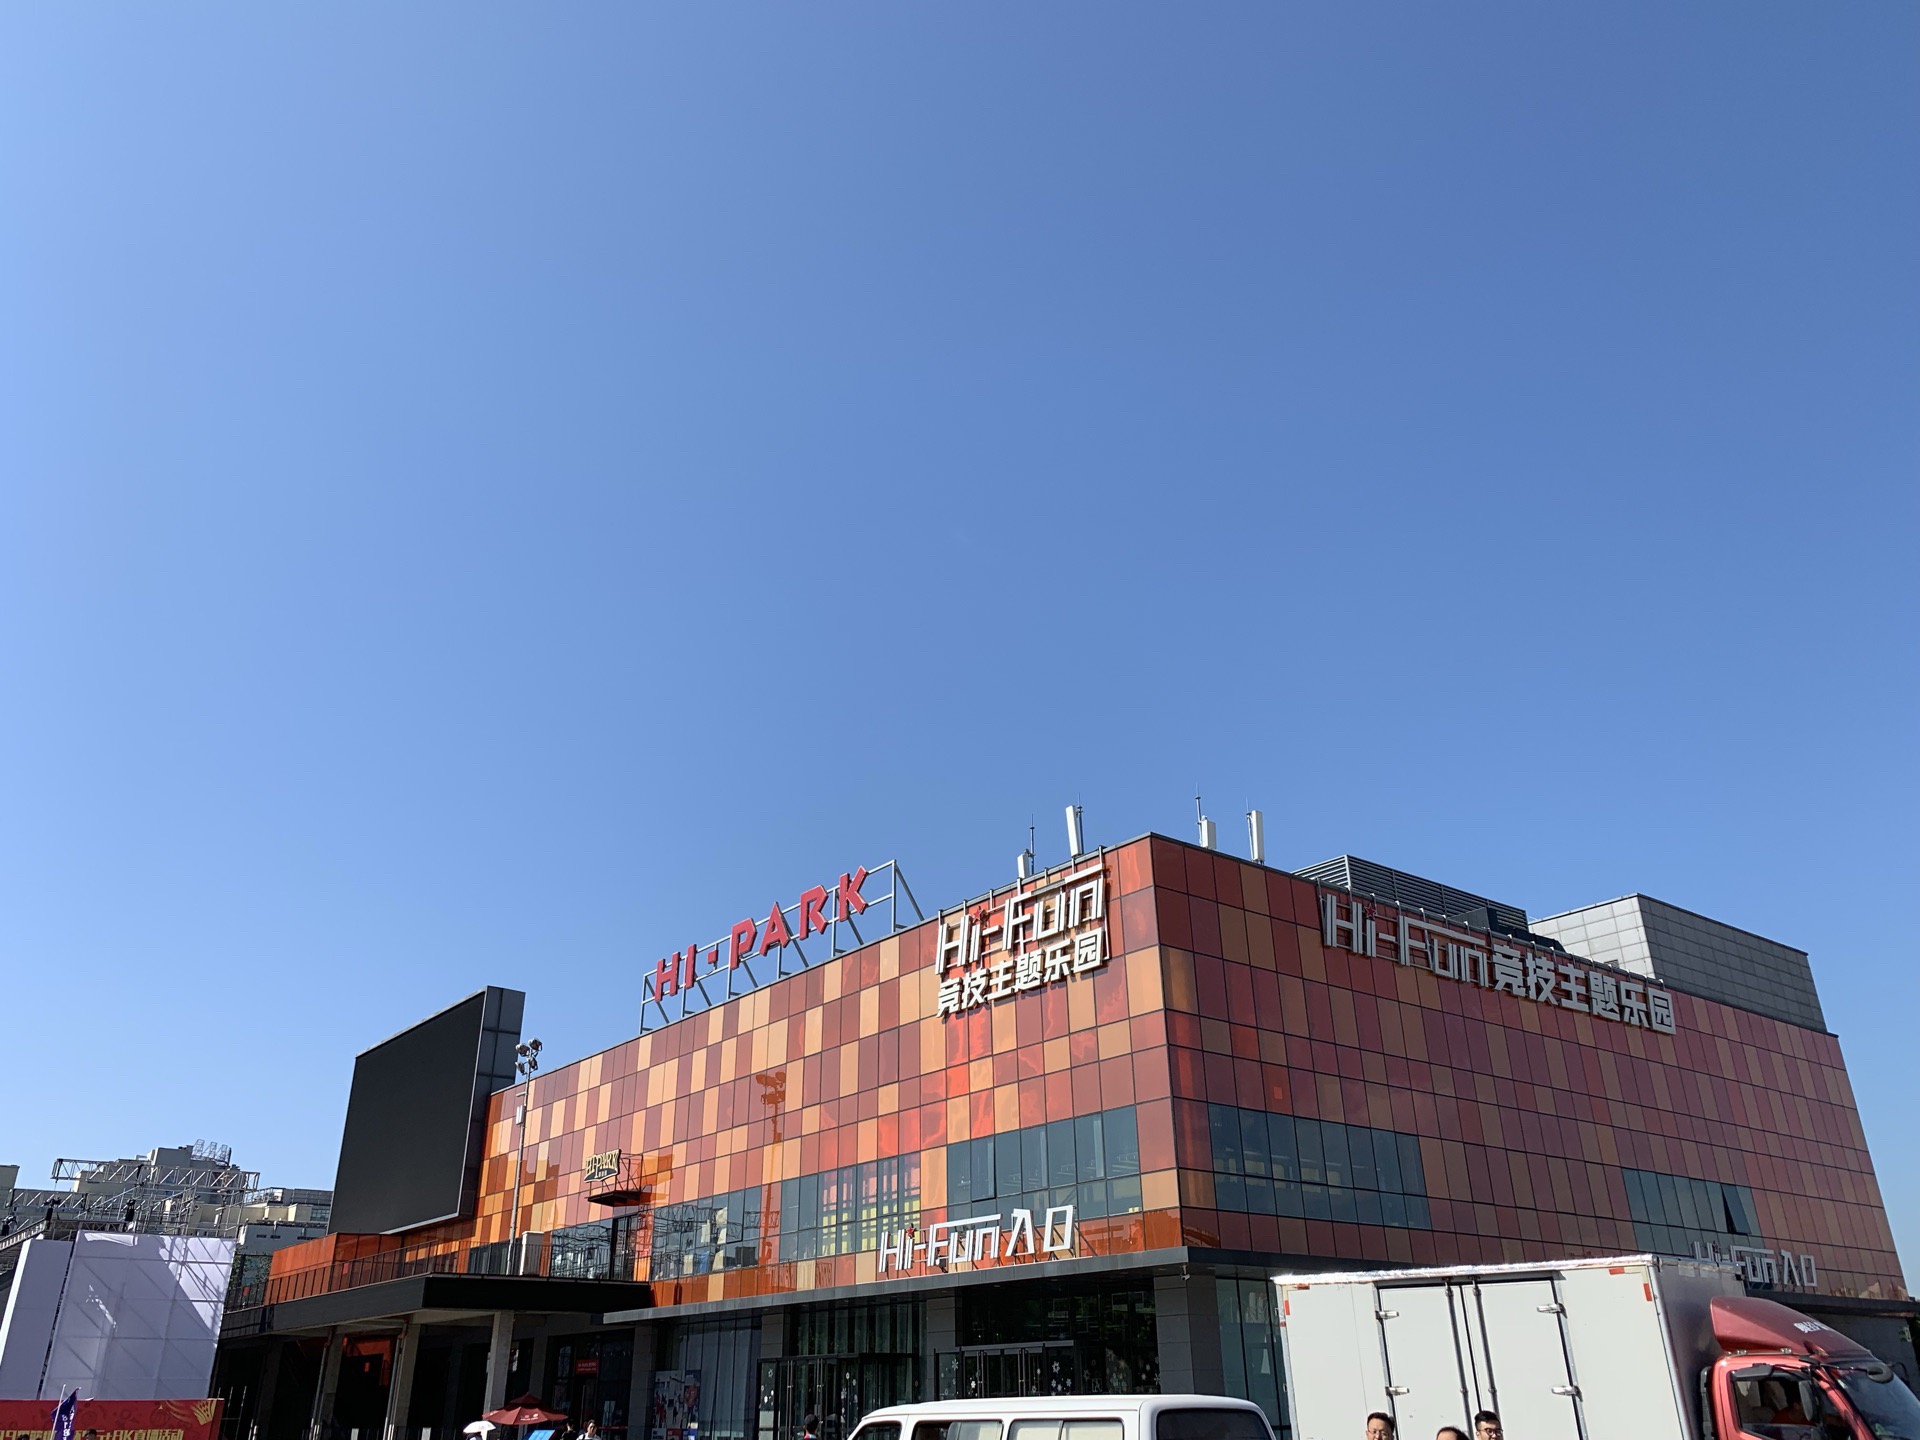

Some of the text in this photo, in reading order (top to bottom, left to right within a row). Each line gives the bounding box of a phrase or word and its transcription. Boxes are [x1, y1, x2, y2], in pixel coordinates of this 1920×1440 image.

[935, 926, 1105, 1018] 竞技主题乐园
[1492, 944, 1677, 1035] 竞技主题乐园
